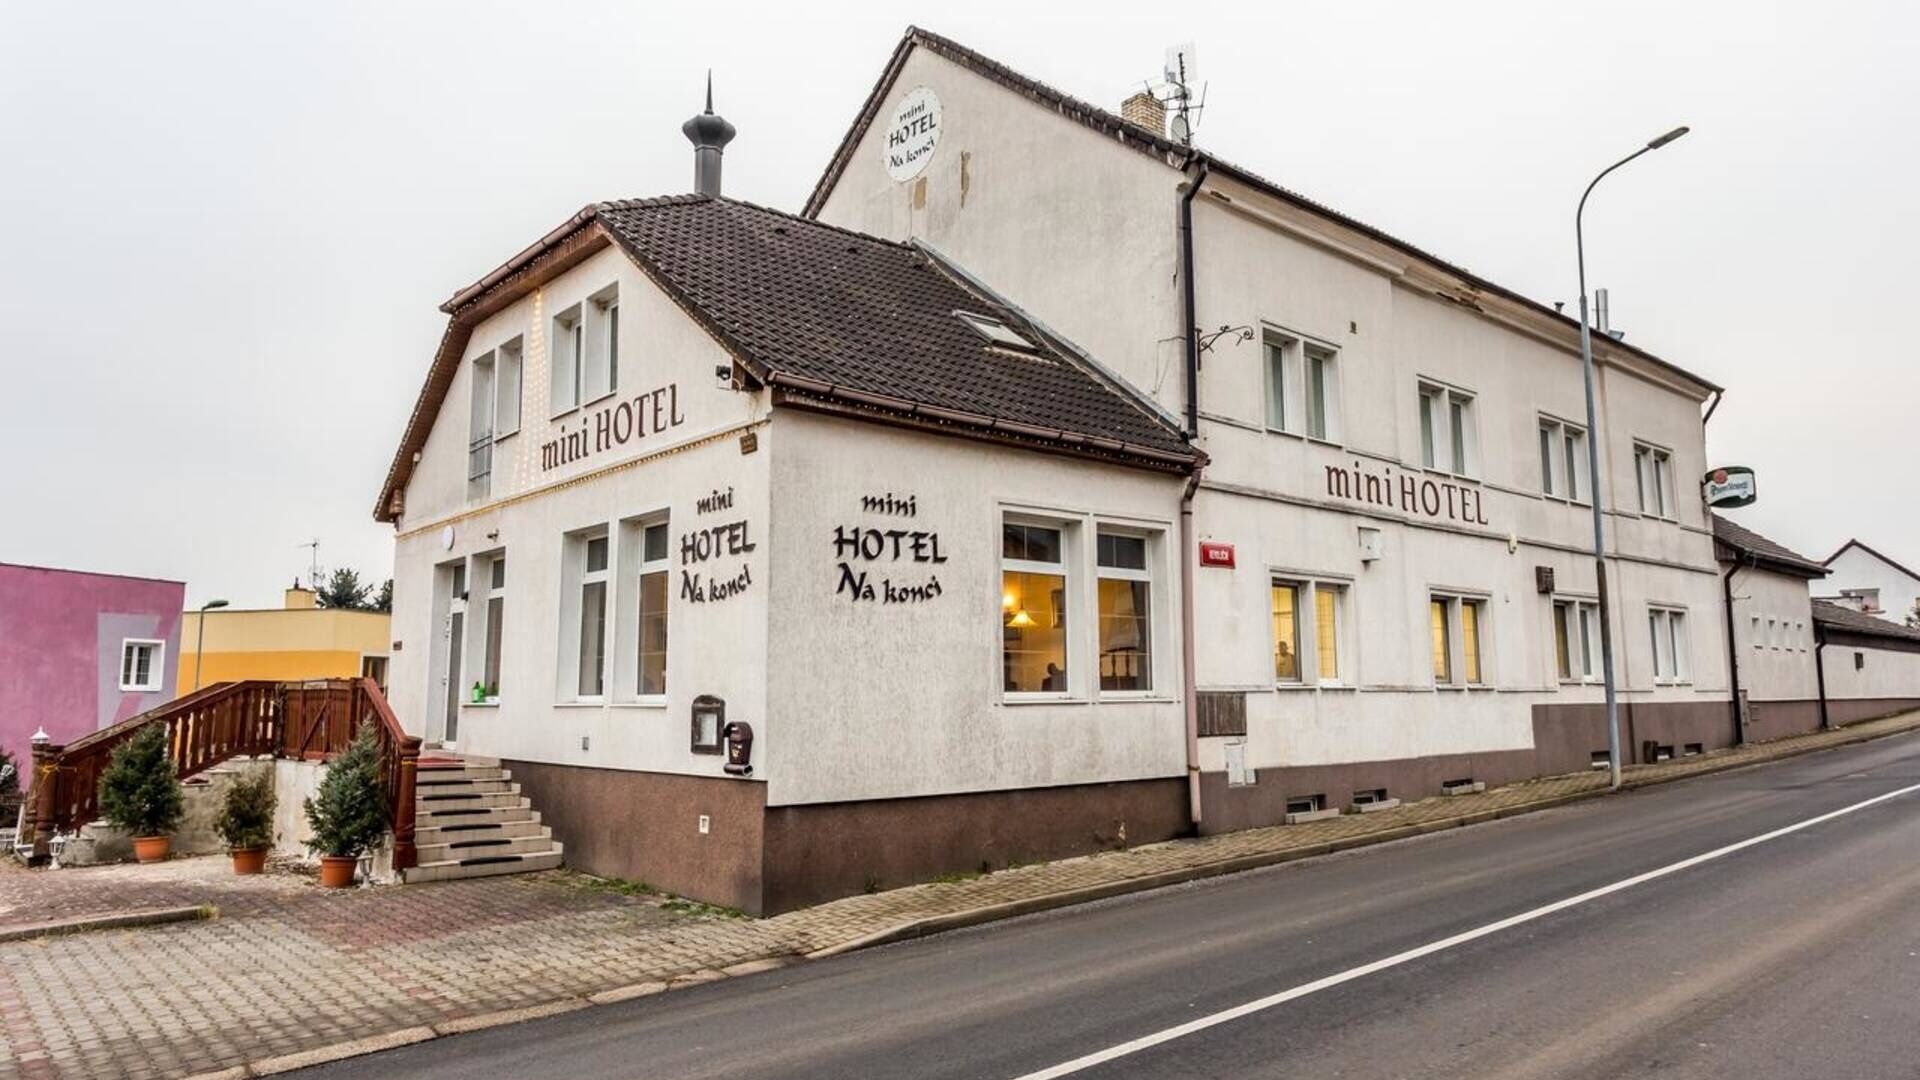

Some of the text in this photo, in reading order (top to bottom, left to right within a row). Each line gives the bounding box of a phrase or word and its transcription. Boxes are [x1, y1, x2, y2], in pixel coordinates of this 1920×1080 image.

[899, 100, 925, 122] mini
[889, 112, 936, 148] HOTEL
[889, 155, 904, 167] Na
[541, 383, 685, 472] mini HOTEL
[697, 486, 734, 515] mini
[861, 492, 916, 517] mini
[1325, 460, 1489, 525] mini HOTEL
[681, 519, 756, 565] HOTEL
[833, 525, 948, 563] HOTEL
[681, 569, 705, 603] Na
[836, 561, 875, 602] Na
